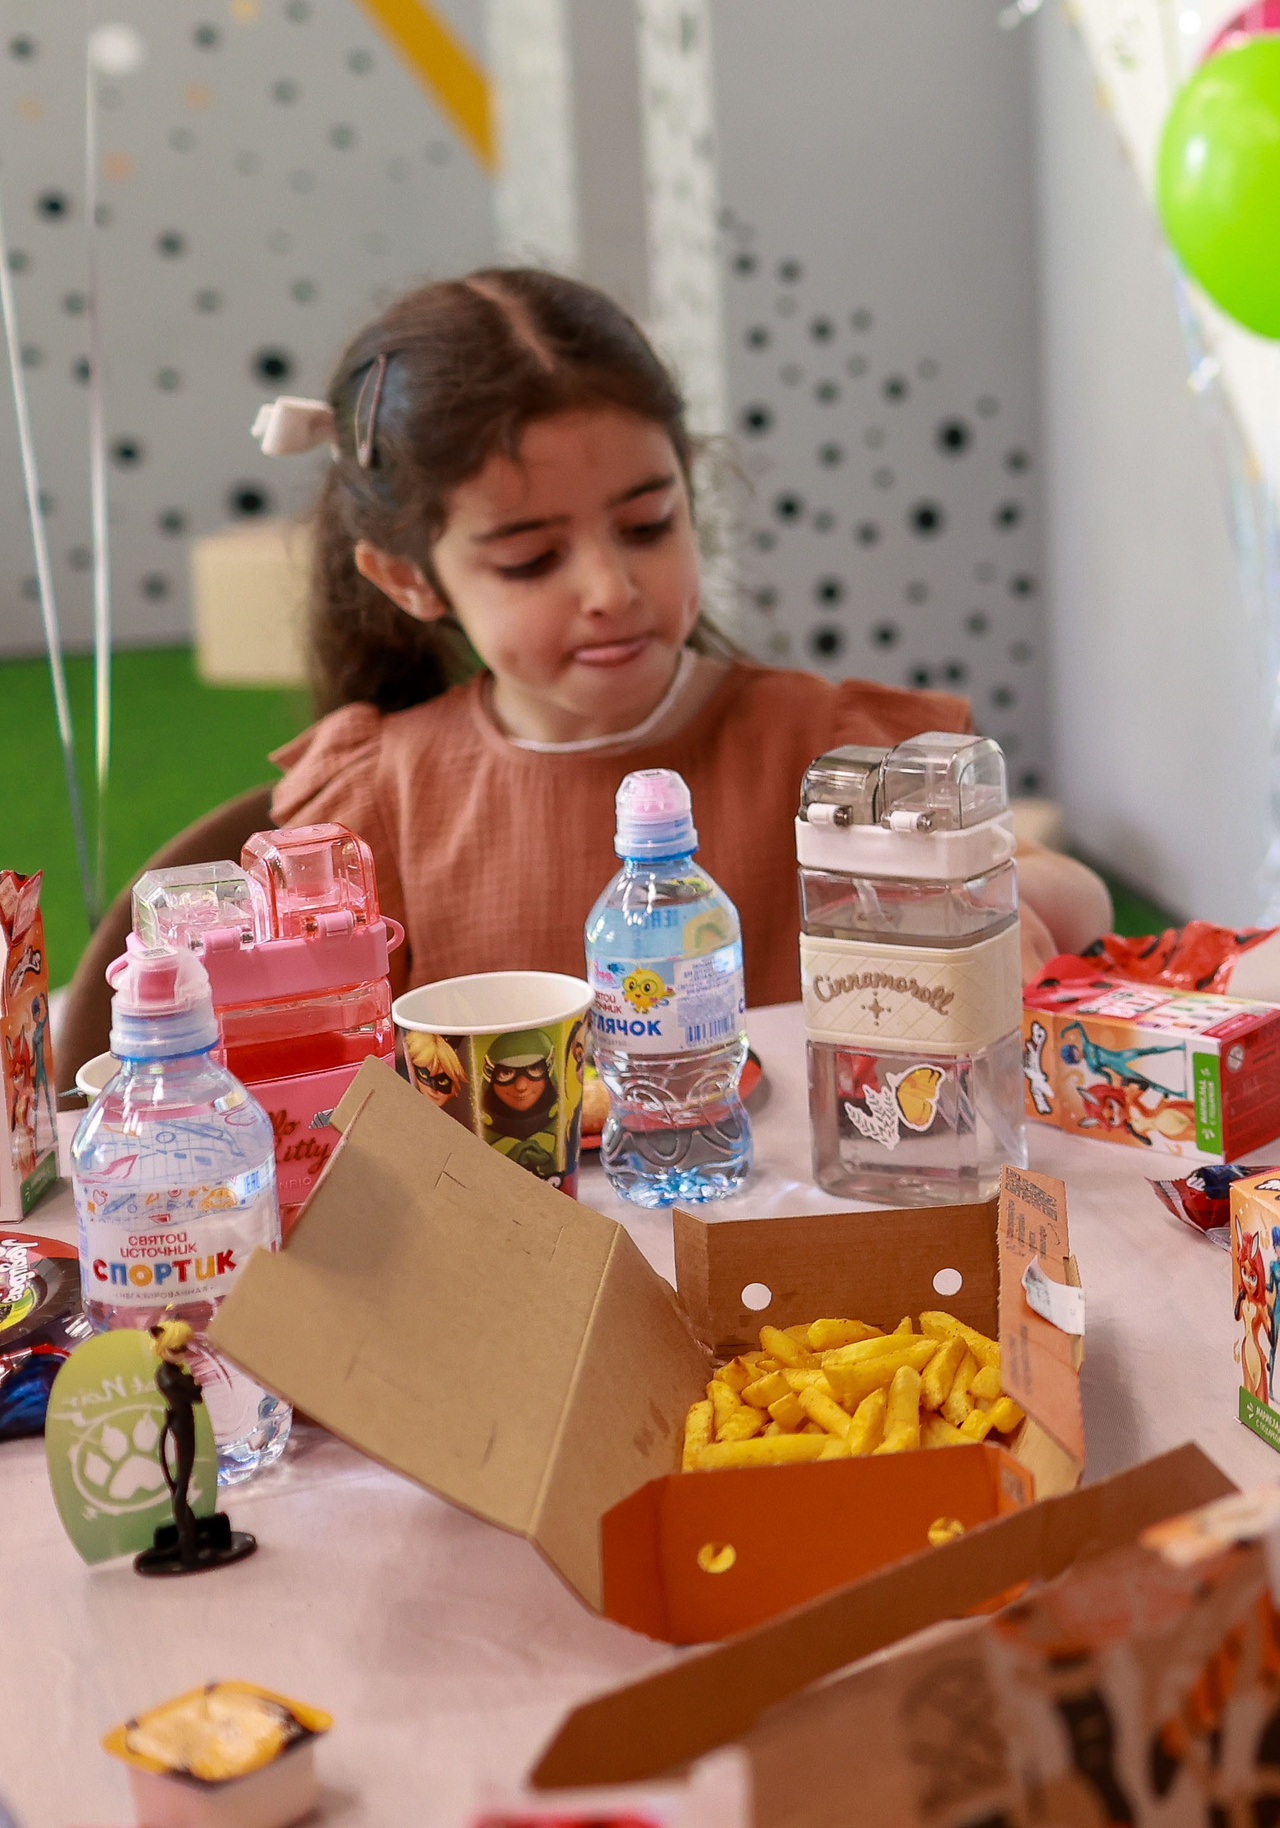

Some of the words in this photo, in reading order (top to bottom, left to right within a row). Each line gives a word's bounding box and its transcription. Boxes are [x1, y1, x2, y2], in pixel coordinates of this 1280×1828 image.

[813, 971, 955, 1016] Cinnamoroll
[275, 1137, 331, 1175] itty
[280, 1177, 312, 1191] NRIO
[120, 1242, 198, 1259] ИСТОЧНИК
[128, 1231, 188, 1247] СВЯТОЙ
[93, 1249, 237, 1287] СПОРТИК
